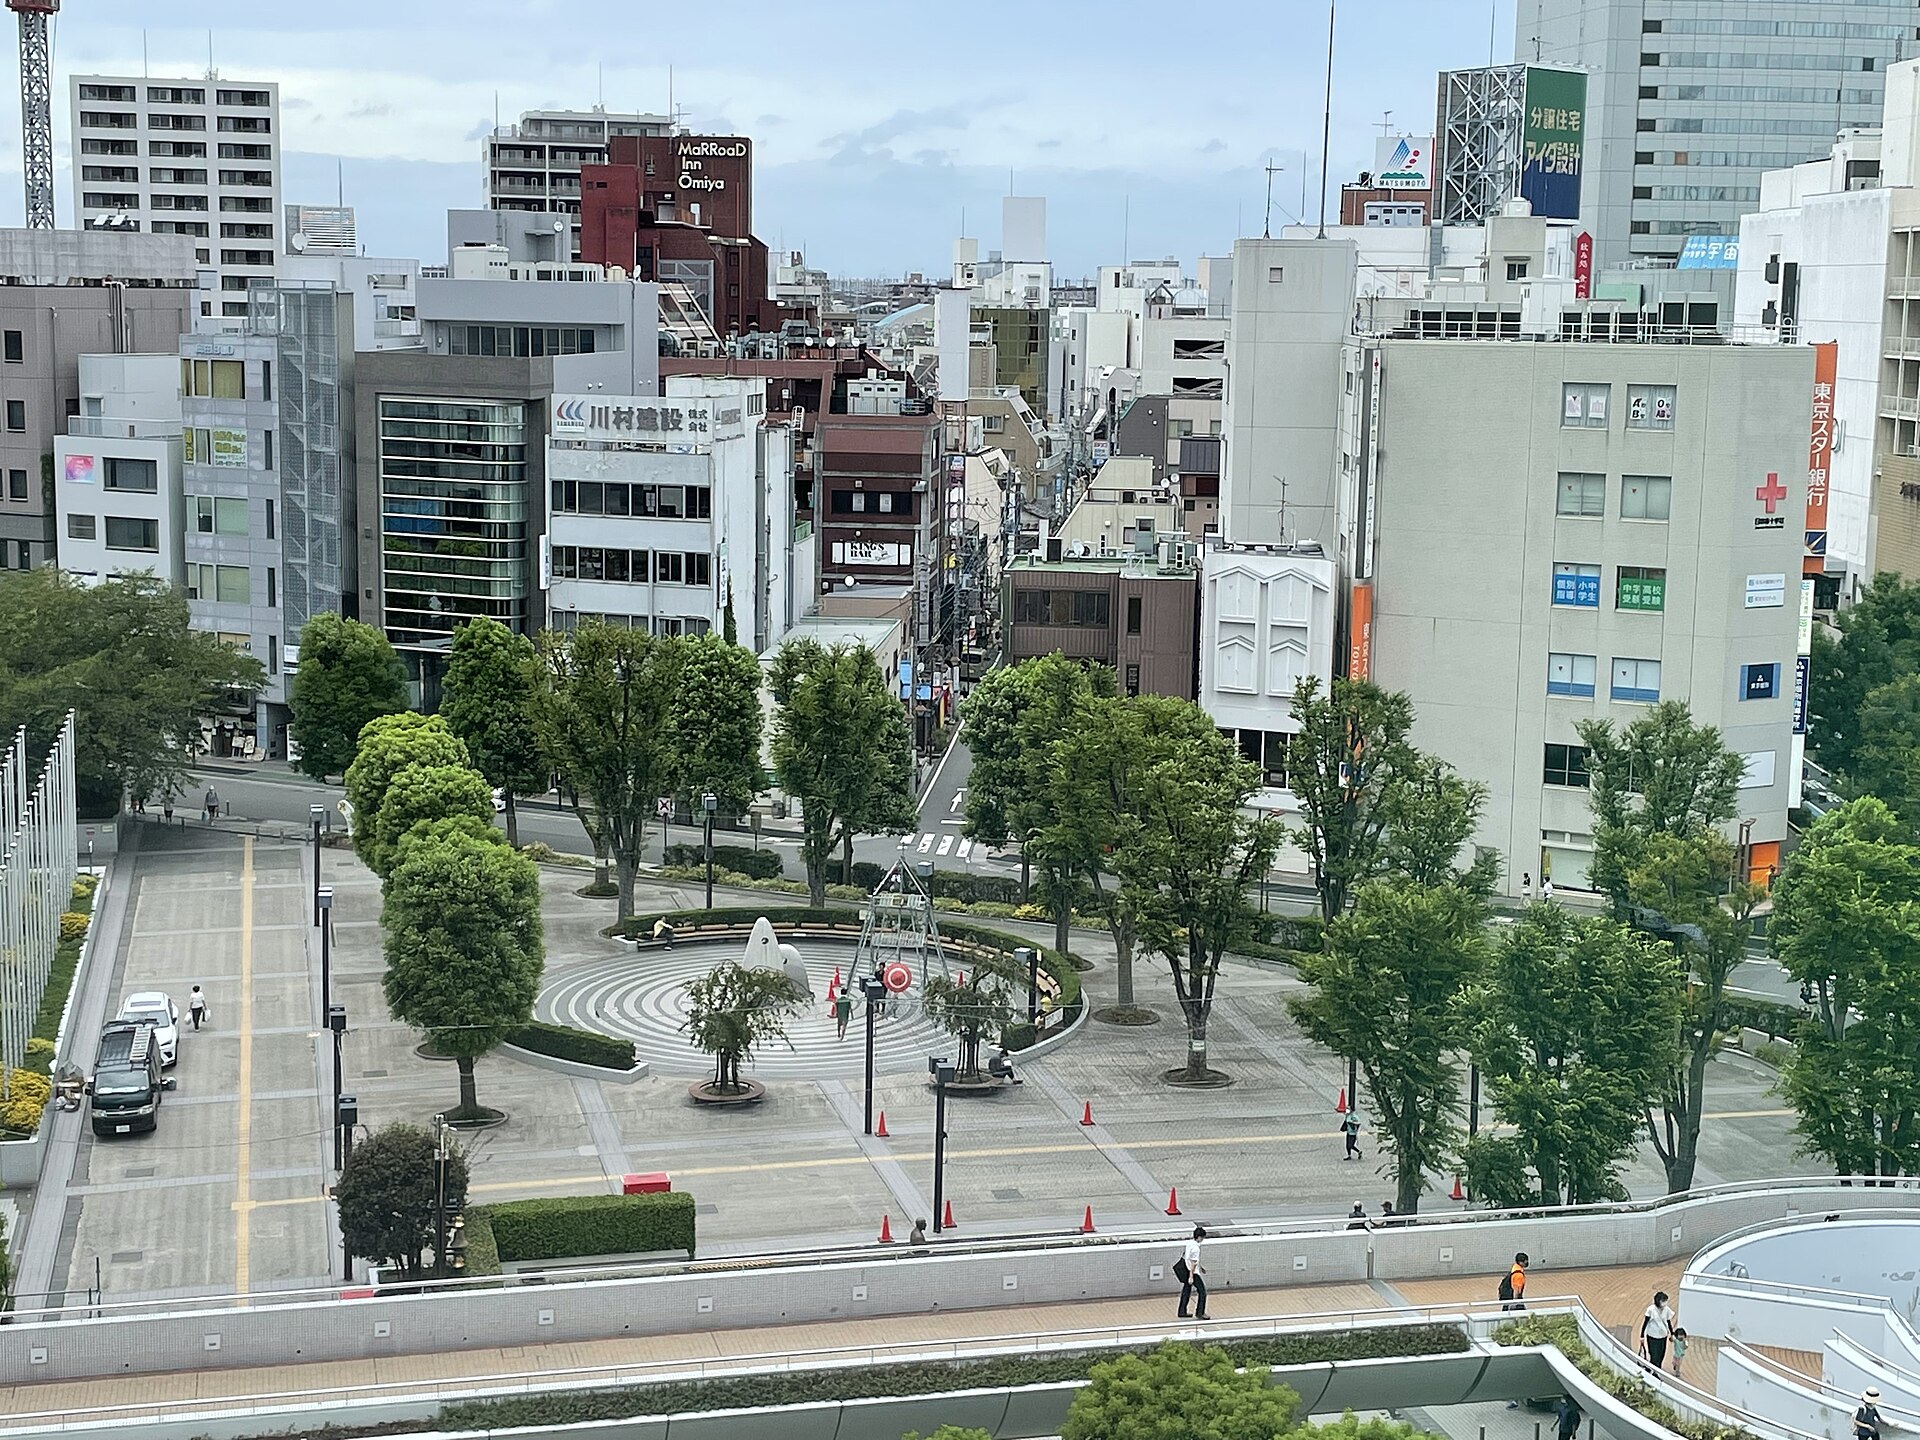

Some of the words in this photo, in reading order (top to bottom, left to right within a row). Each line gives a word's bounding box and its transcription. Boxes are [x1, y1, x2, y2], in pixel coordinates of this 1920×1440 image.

[1530, 106, 1581, 131] 分譲住宅
[682, 156, 702, 170] Inn
[1523, 140, 1581, 175] アイダ設計
[678, 171, 725, 192] Ōmiya
[1379, 179, 1426, 187] MATSUMOTO
[589, 405, 683, 432] 川村建設
[688, 408, 708, 420] 株式
[688, 421, 708, 433] 会社
[1807, 382, 1832, 507] 東京スター銀行
[850, 550, 872, 558] BAR
[1578, 581, 1597, 591] 小中
[1622, 584, 1640, 594] 中学
[1642, 585, 1662, 595] 高校
[1578, 592, 1597, 602] 学生
[1622, 594, 1640, 604] 受験
[1642, 595, 1661, 605] 受験
[1351, 645, 1360, 680] TOKYO
